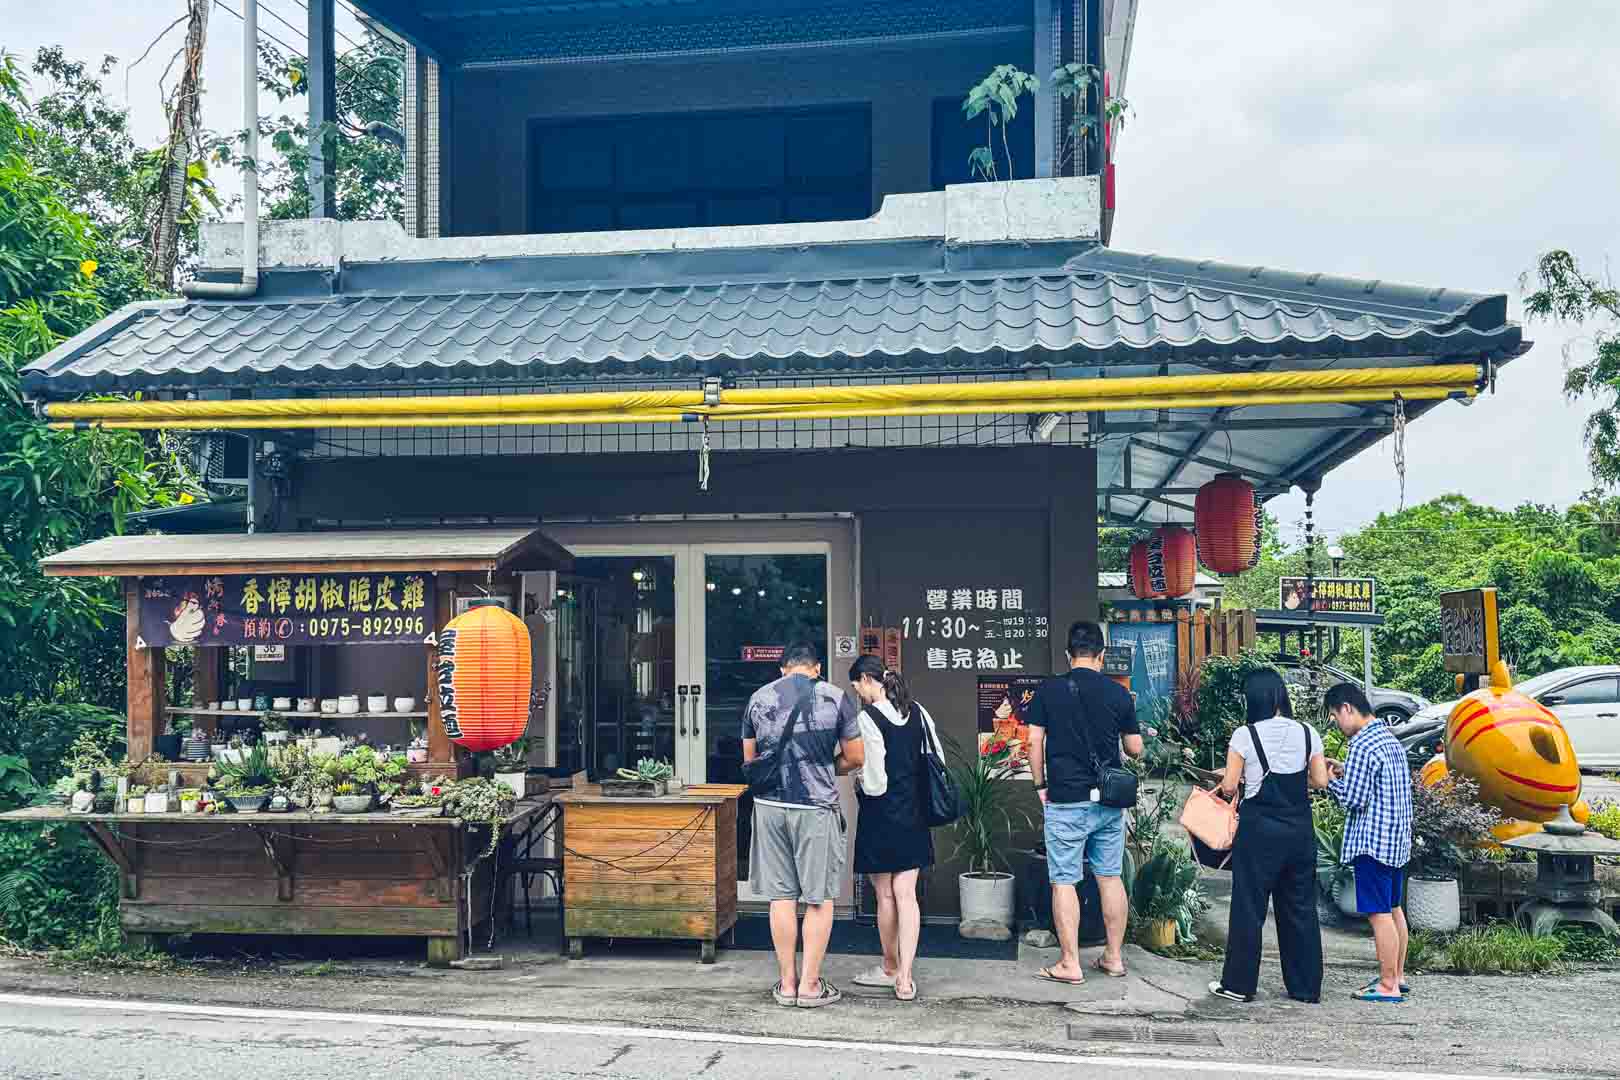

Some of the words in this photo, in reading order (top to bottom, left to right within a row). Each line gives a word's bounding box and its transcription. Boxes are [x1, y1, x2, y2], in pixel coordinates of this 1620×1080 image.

[240, 576, 425, 614] 香檸胡椒脆皮雞
[926, 588, 1023, 610] 營業時間
[243, 617, 271, 639] 預約
[926, 647, 1024, 669] 售完為止
